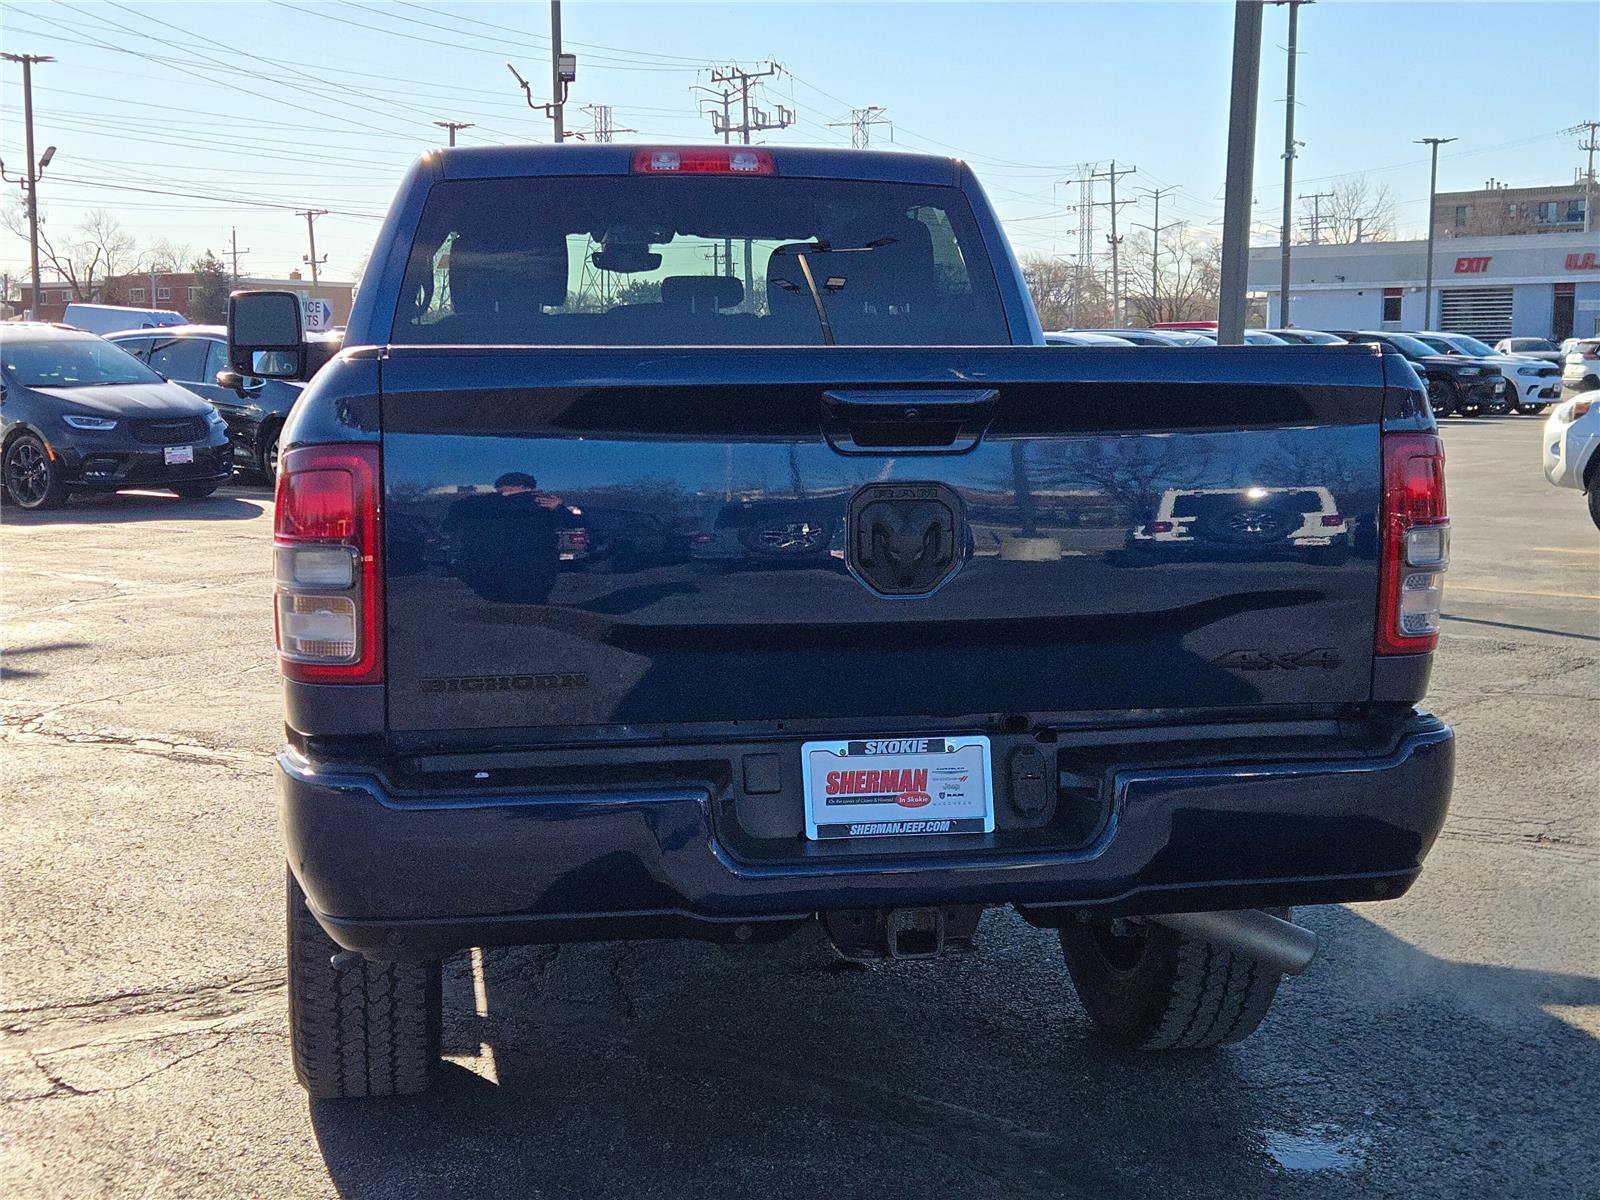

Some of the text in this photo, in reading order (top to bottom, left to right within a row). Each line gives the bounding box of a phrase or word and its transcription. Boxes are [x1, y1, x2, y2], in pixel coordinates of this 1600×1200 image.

[1454, 256, 1493, 273] EXIT
[864, 739, 929, 755] SKOKIE
[825, 768, 929, 795] SHERMAN
[850, 820, 951, 836] SHERMANJEEP.COM
